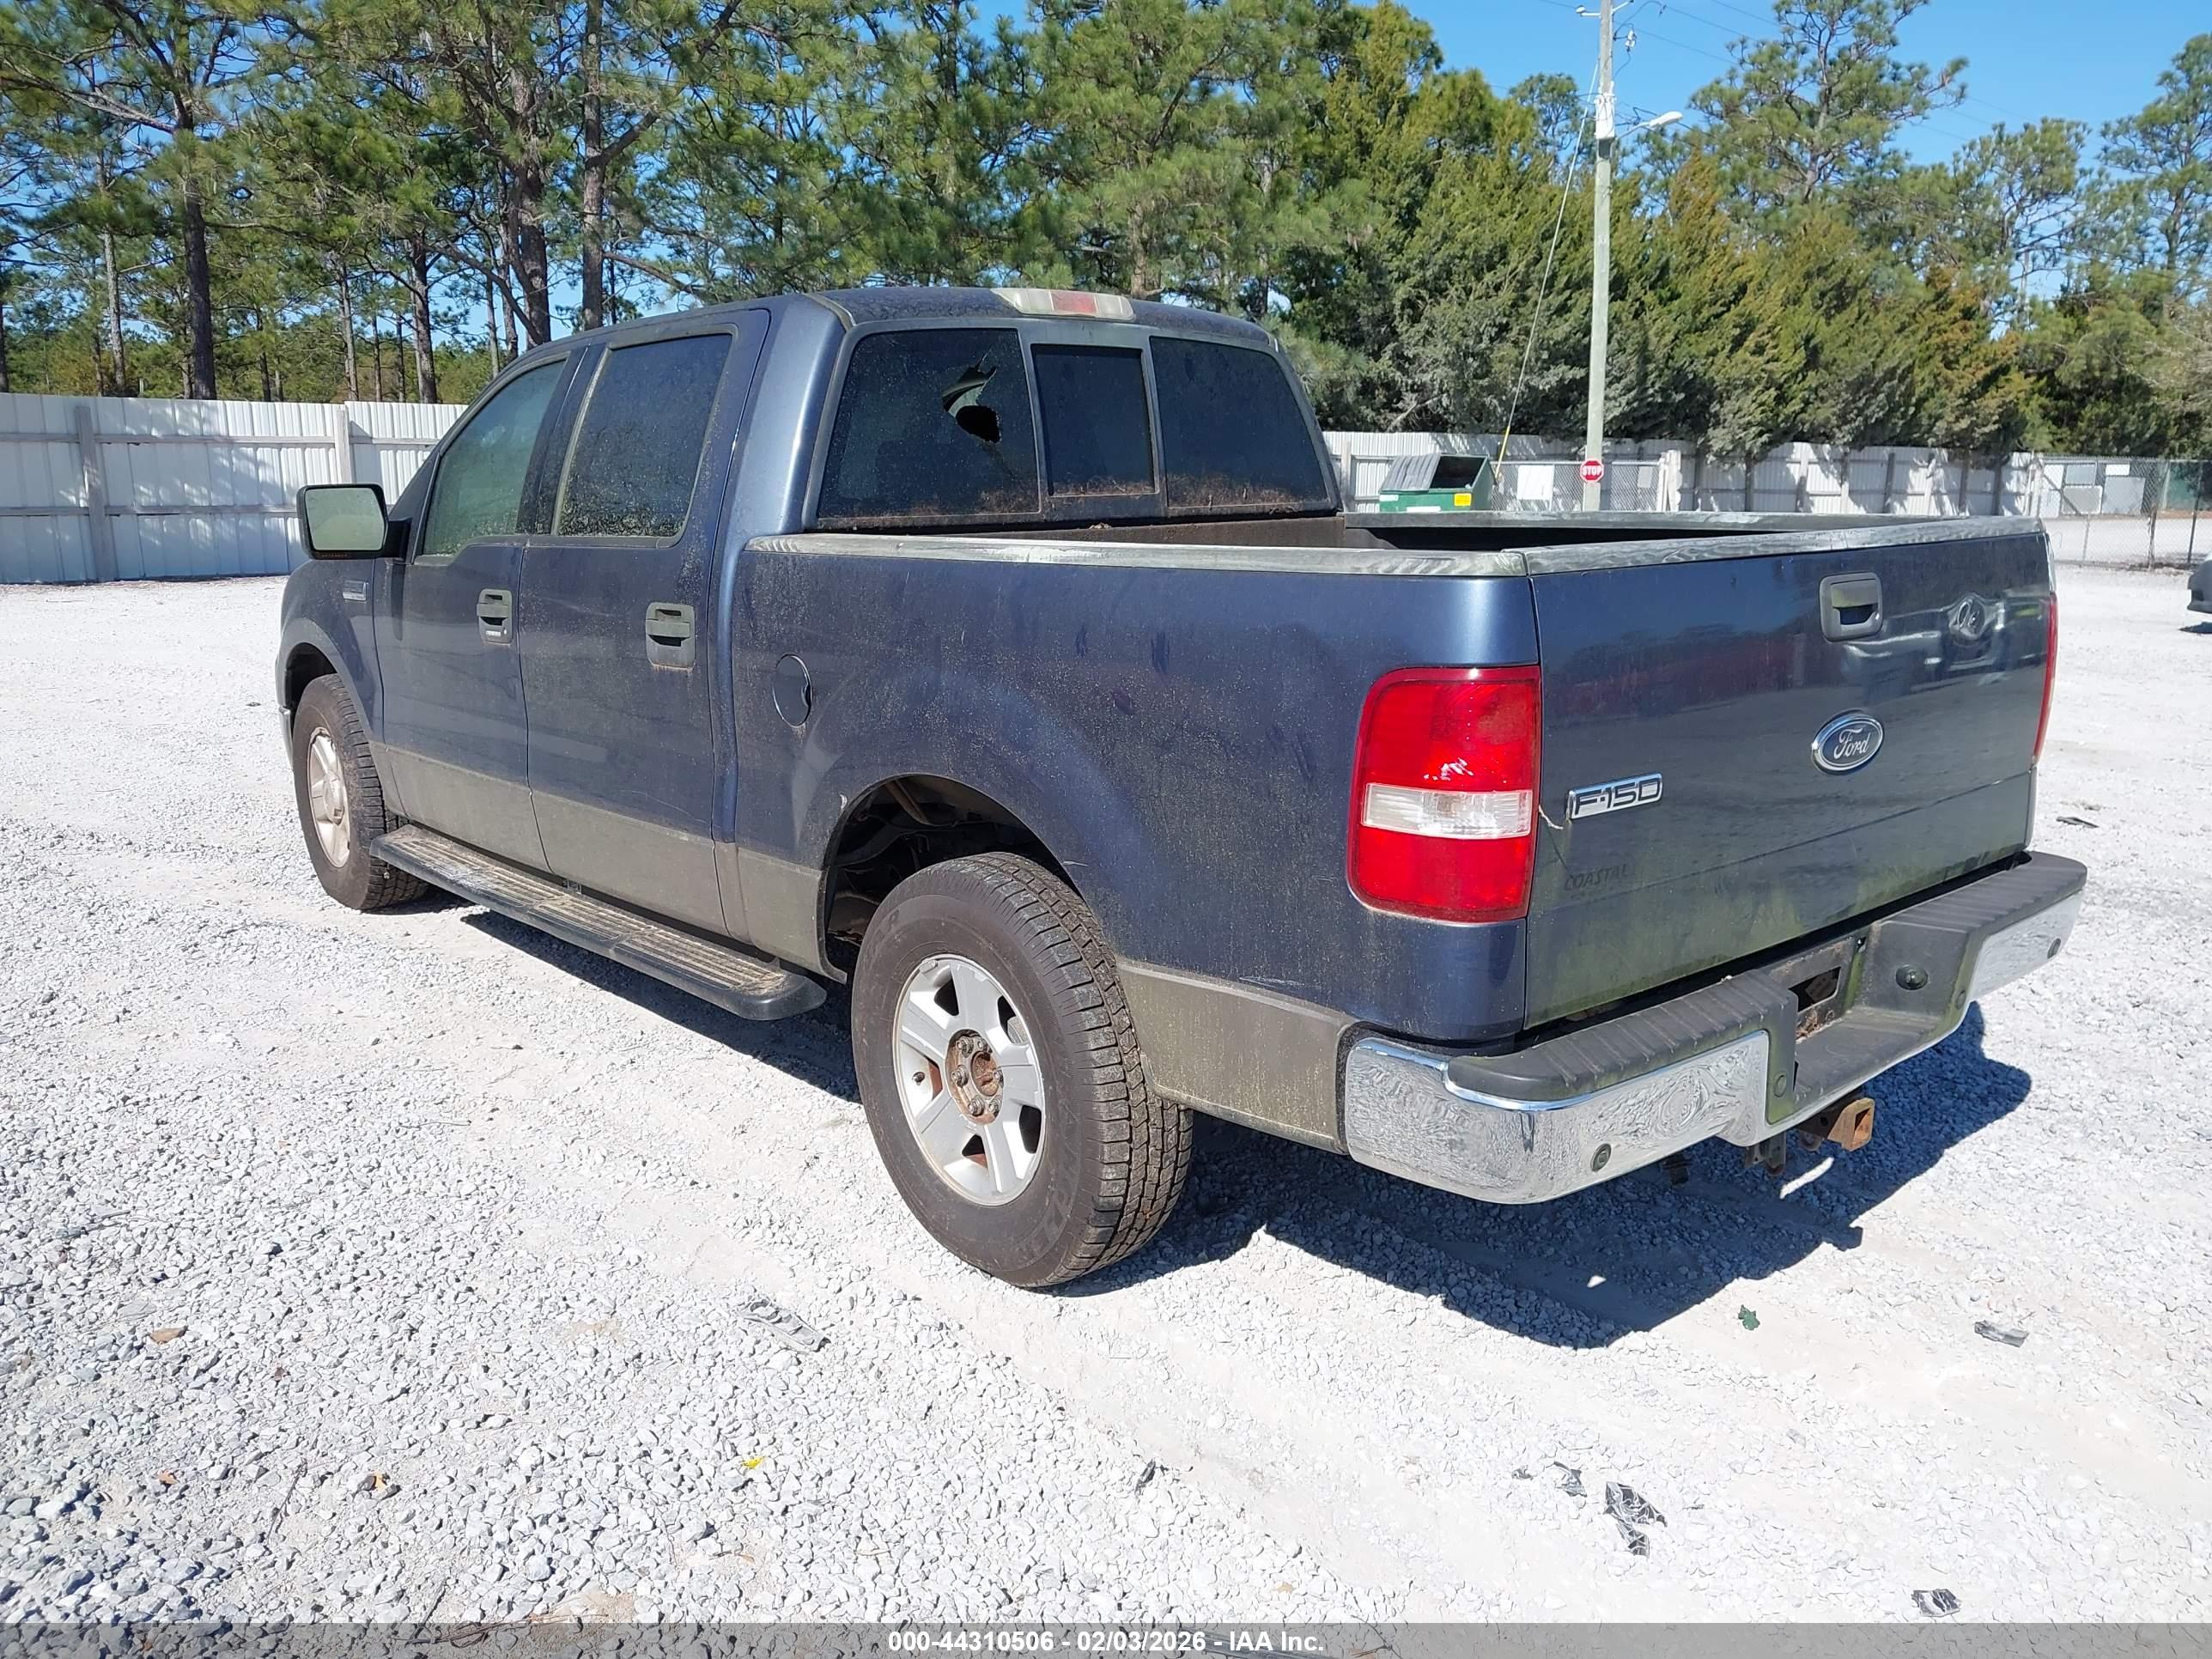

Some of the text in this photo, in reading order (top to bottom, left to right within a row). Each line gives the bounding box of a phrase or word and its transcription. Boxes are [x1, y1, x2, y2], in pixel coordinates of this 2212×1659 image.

[1582, 465, 1602, 477] STOP
[1833, 727, 1871, 759] Ford
[1565, 862, 1631, 891] COASTAL
